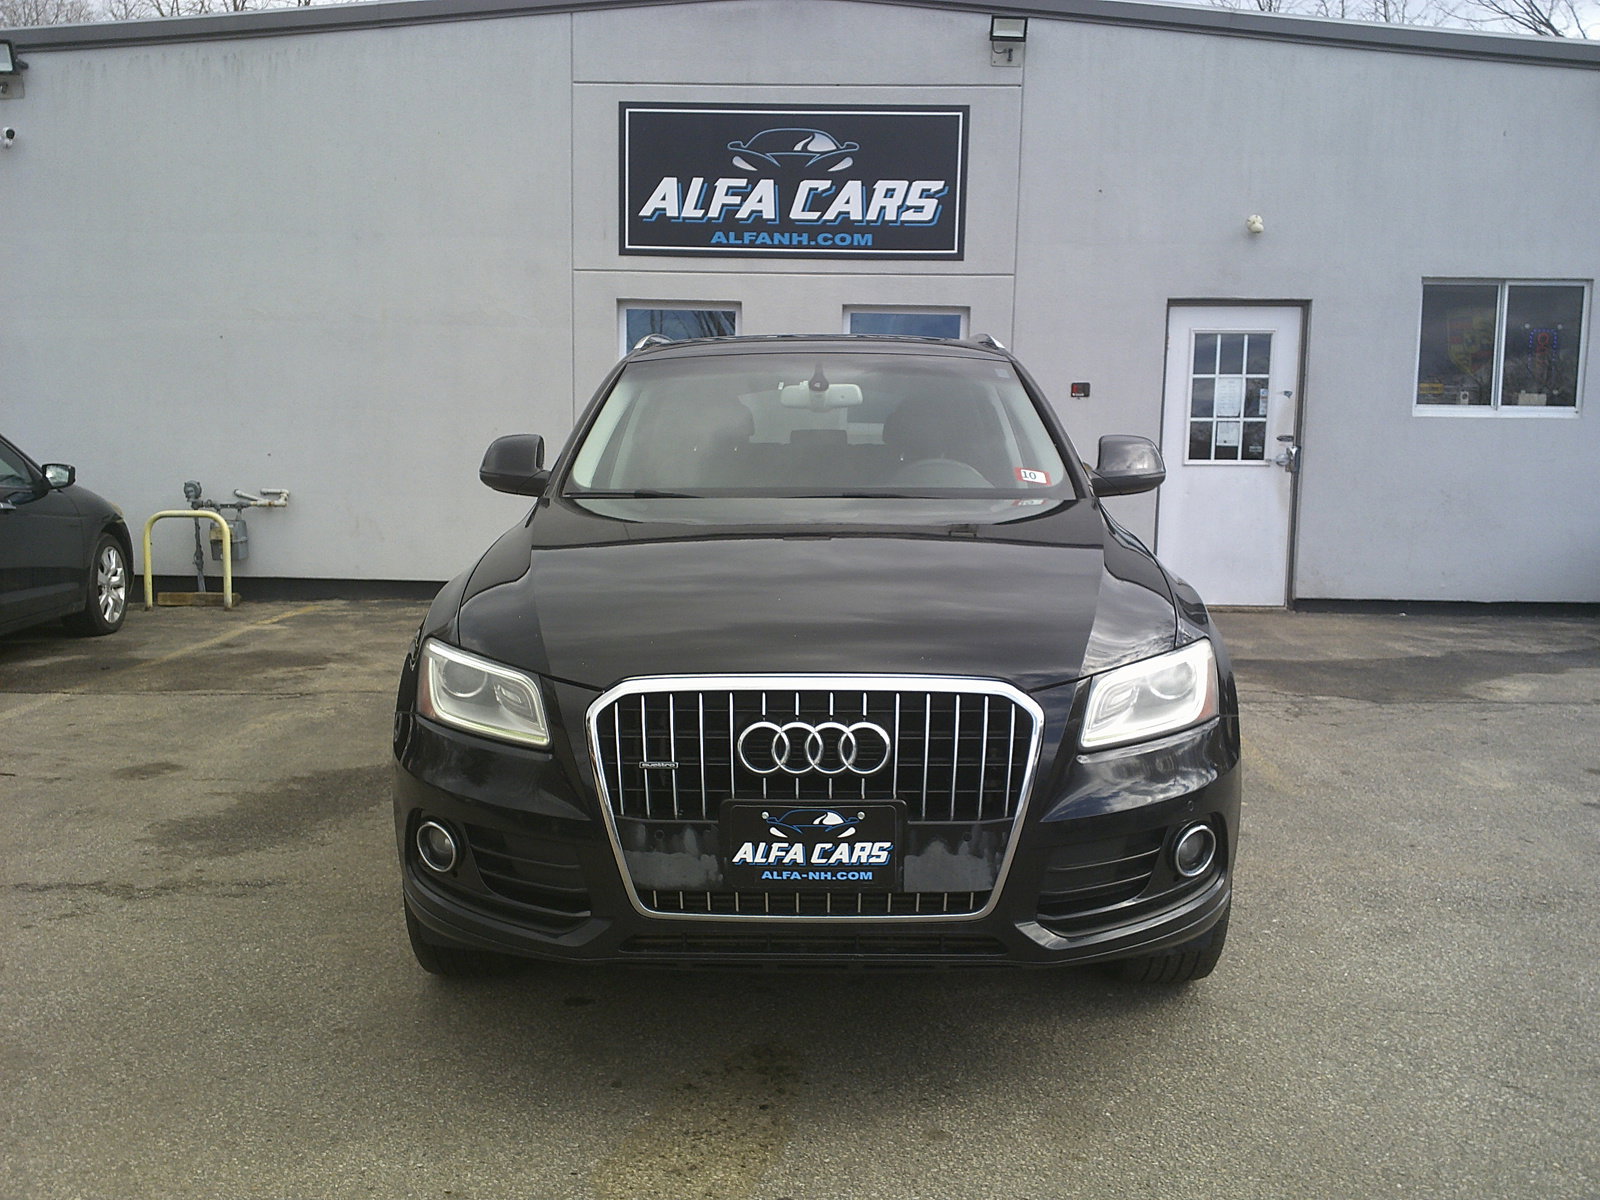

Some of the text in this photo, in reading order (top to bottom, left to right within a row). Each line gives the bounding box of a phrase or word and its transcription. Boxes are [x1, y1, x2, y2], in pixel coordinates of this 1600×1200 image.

[638, 177, 949, 226] ALFA CARS
[711, 231, 874, 246] ALFANH.COM
[1022, 470, 1037, 480] 10
[732, 842, 894, 866] ALFA CARS
[761, 870, 873, 881] ALFA-NH.COM
